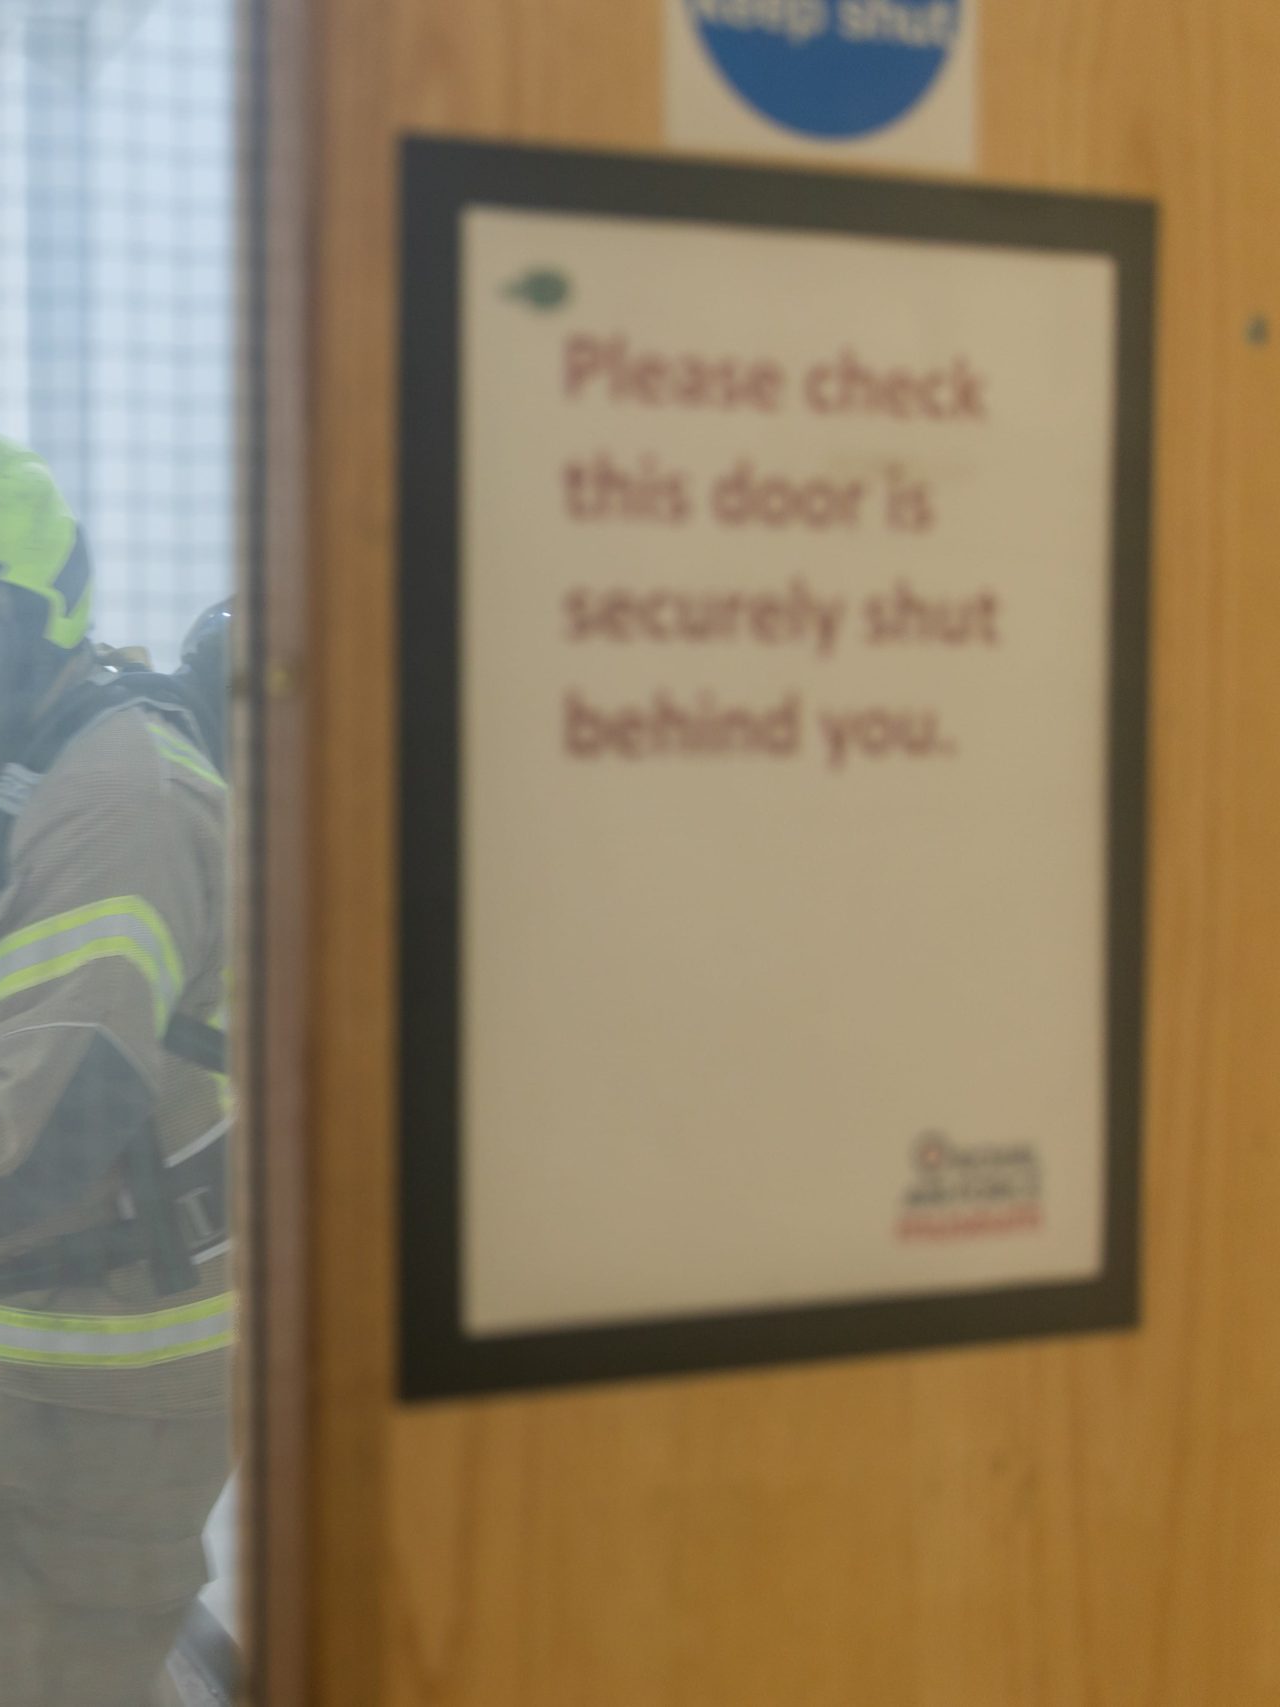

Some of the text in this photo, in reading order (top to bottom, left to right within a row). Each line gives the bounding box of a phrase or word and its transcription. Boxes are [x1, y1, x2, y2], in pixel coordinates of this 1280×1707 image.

[563, 333, 985, 420] Please check
[562, 454, 934, 532] this door is
[563, 582, 998, 653] securely shut
[563, 693, 956, 769] behind you.
